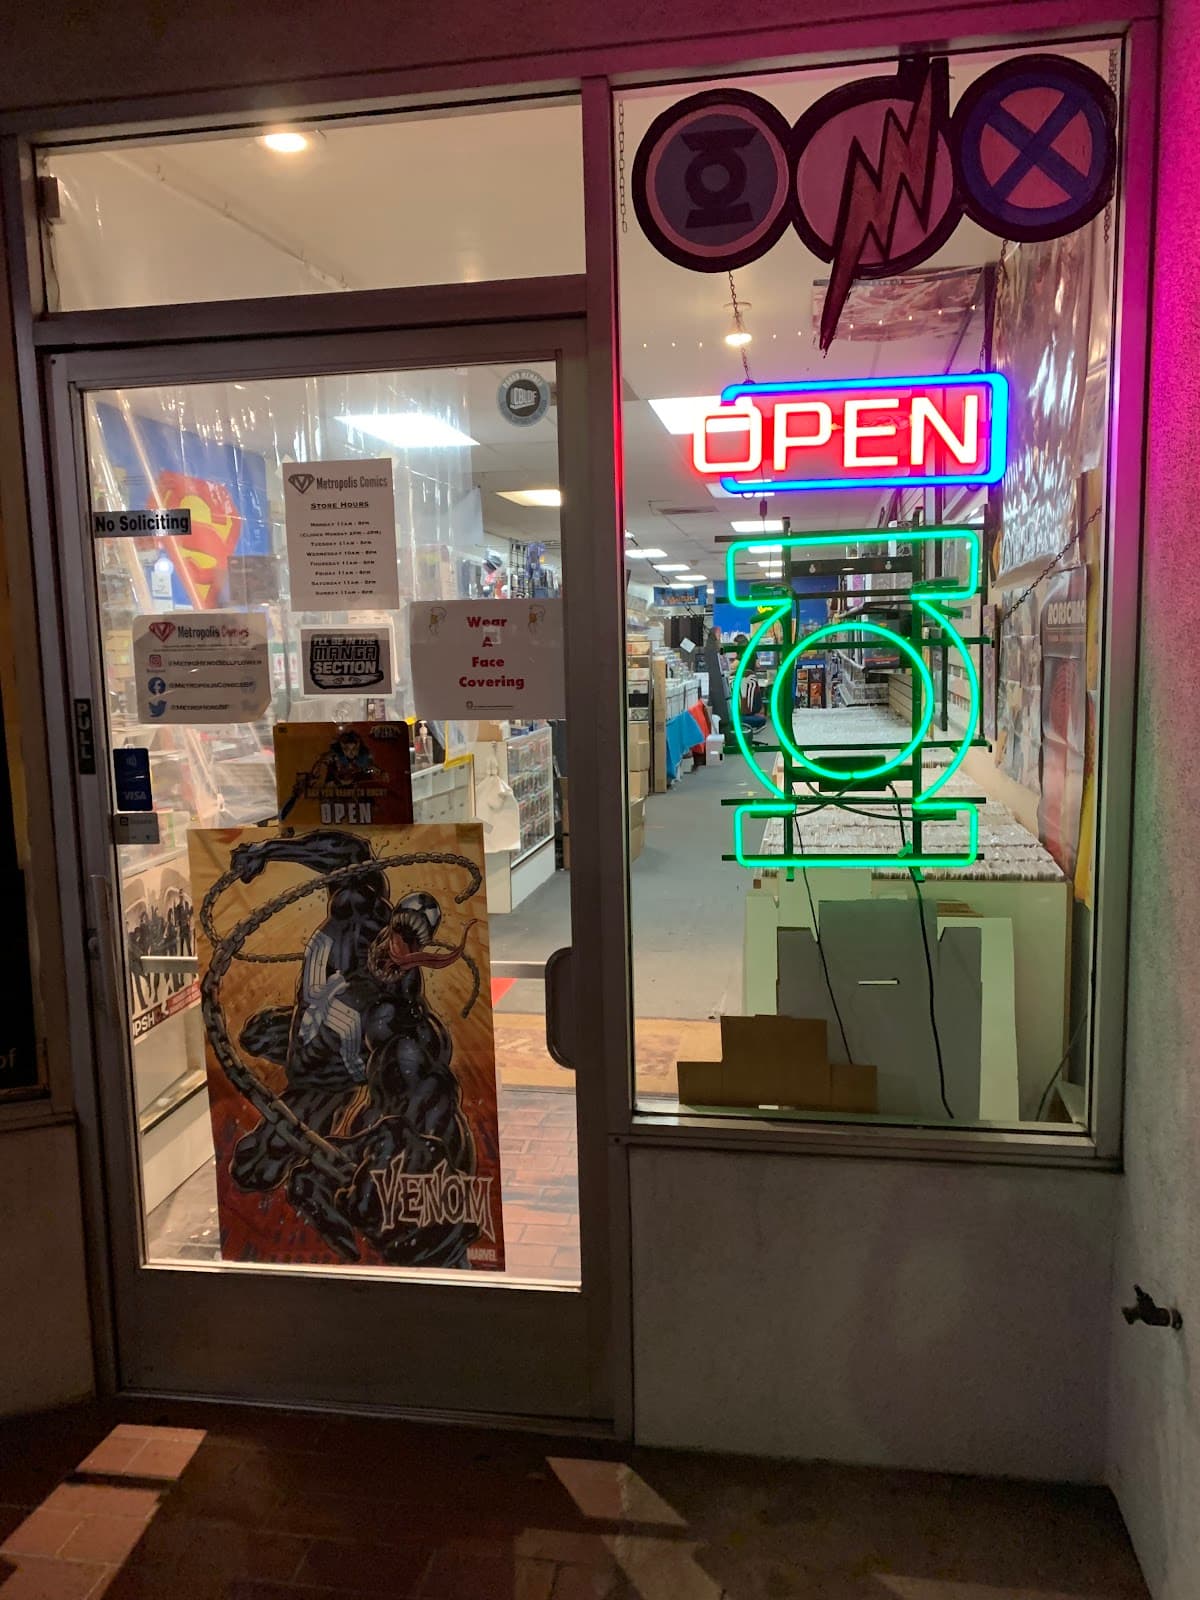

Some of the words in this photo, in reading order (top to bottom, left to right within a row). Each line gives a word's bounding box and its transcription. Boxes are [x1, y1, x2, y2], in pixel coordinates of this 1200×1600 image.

[693, 395, 978, 473] OPEN
[316, 476, 358, 491] Metropolis
[360, 476, 388, 488] Comics
[95, 518, 115, 532] No
[120, 515, 189, 533] Soliciting
[466, 616, 508, 628] Wear
[178, 625, 220, 640] Metropolis
[482, 636, 493, 648] A
[313, 645, 377, 661] MANGA
[313, 661, 376, 675] SECTION
[472, 656, 505, 668] Face
[459, 676, 525, 690] Covering
[77, 704, 92, 759] PULL
[124, 791, 147, 801] VISA
[320, 802, 372, 824] OPEN
[369, 1149, 497, 1244] VENOM
[467, 1248, 498, 1262] MARVEL
